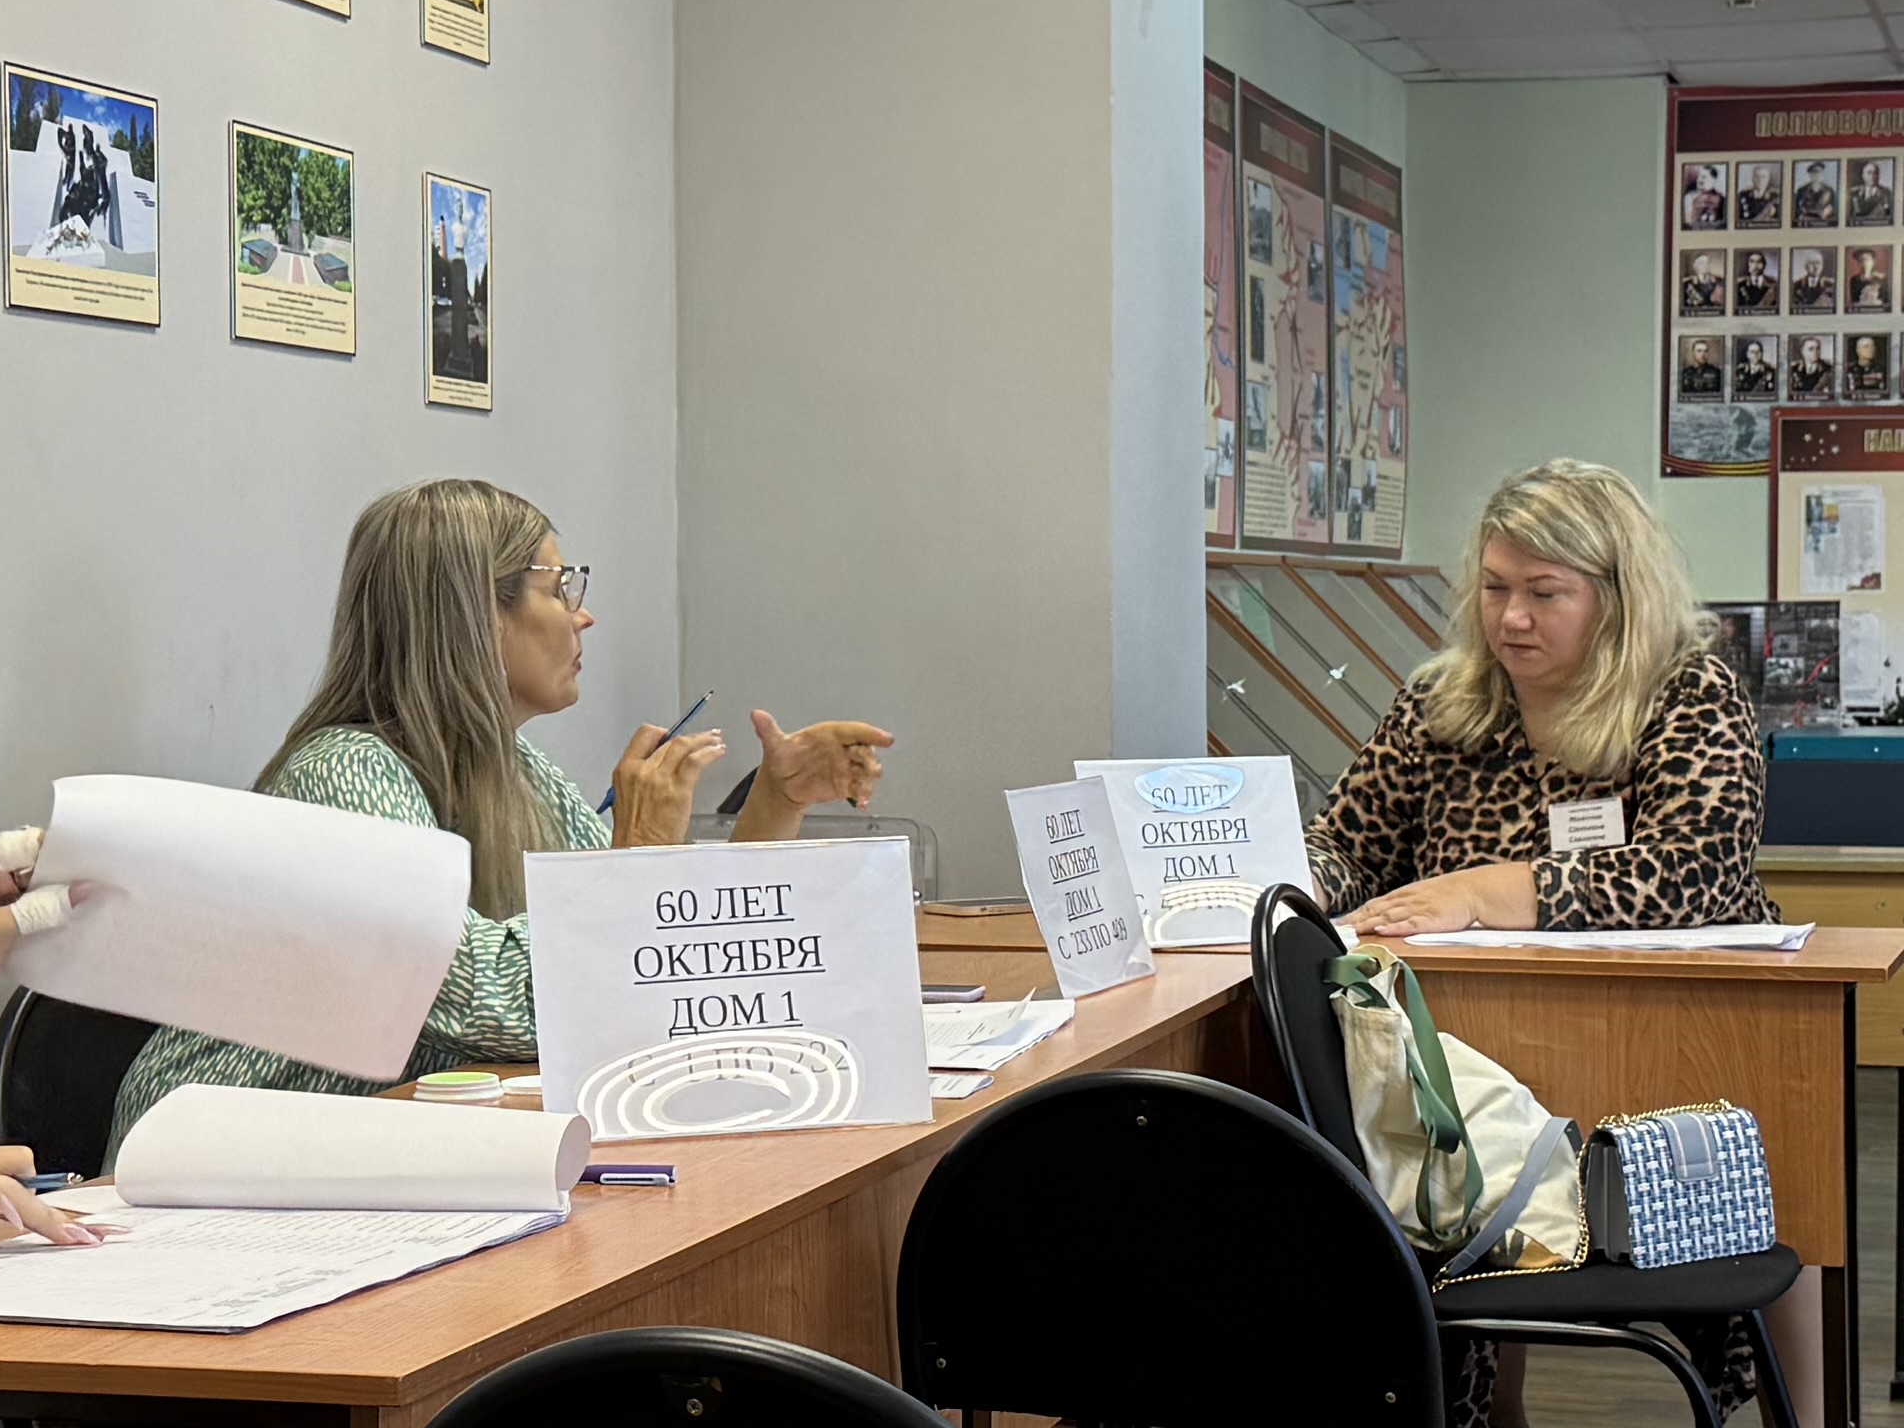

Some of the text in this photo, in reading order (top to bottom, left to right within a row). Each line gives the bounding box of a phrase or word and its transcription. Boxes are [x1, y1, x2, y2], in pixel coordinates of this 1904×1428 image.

[1182, 784, 1229, 806] ЛЕТ
[1060, 809, 1083, 836] ЛЕТ
[1142, 818, 1249, 845] ОКТЯБРЯ
[1049, 846, 1100, 880] ОКТЯБРЯ
[1164, 855, 1238, 882] ДОМ 1
[657, 884, 792, 923] 60 ЛЕТ
[1066, 886, 1103, 917] ДОМ 1
[633, 934, 825, 980] ОКТЯБРЯ
[1057, 936, 1071, 959] С
[1070, 930, 1093, 955] 233
[1089, 923, 1111, 950] ПО
[670, 991, 799, 1038] ДОМ 1
[711, 1046, 776, 1082] ПО
